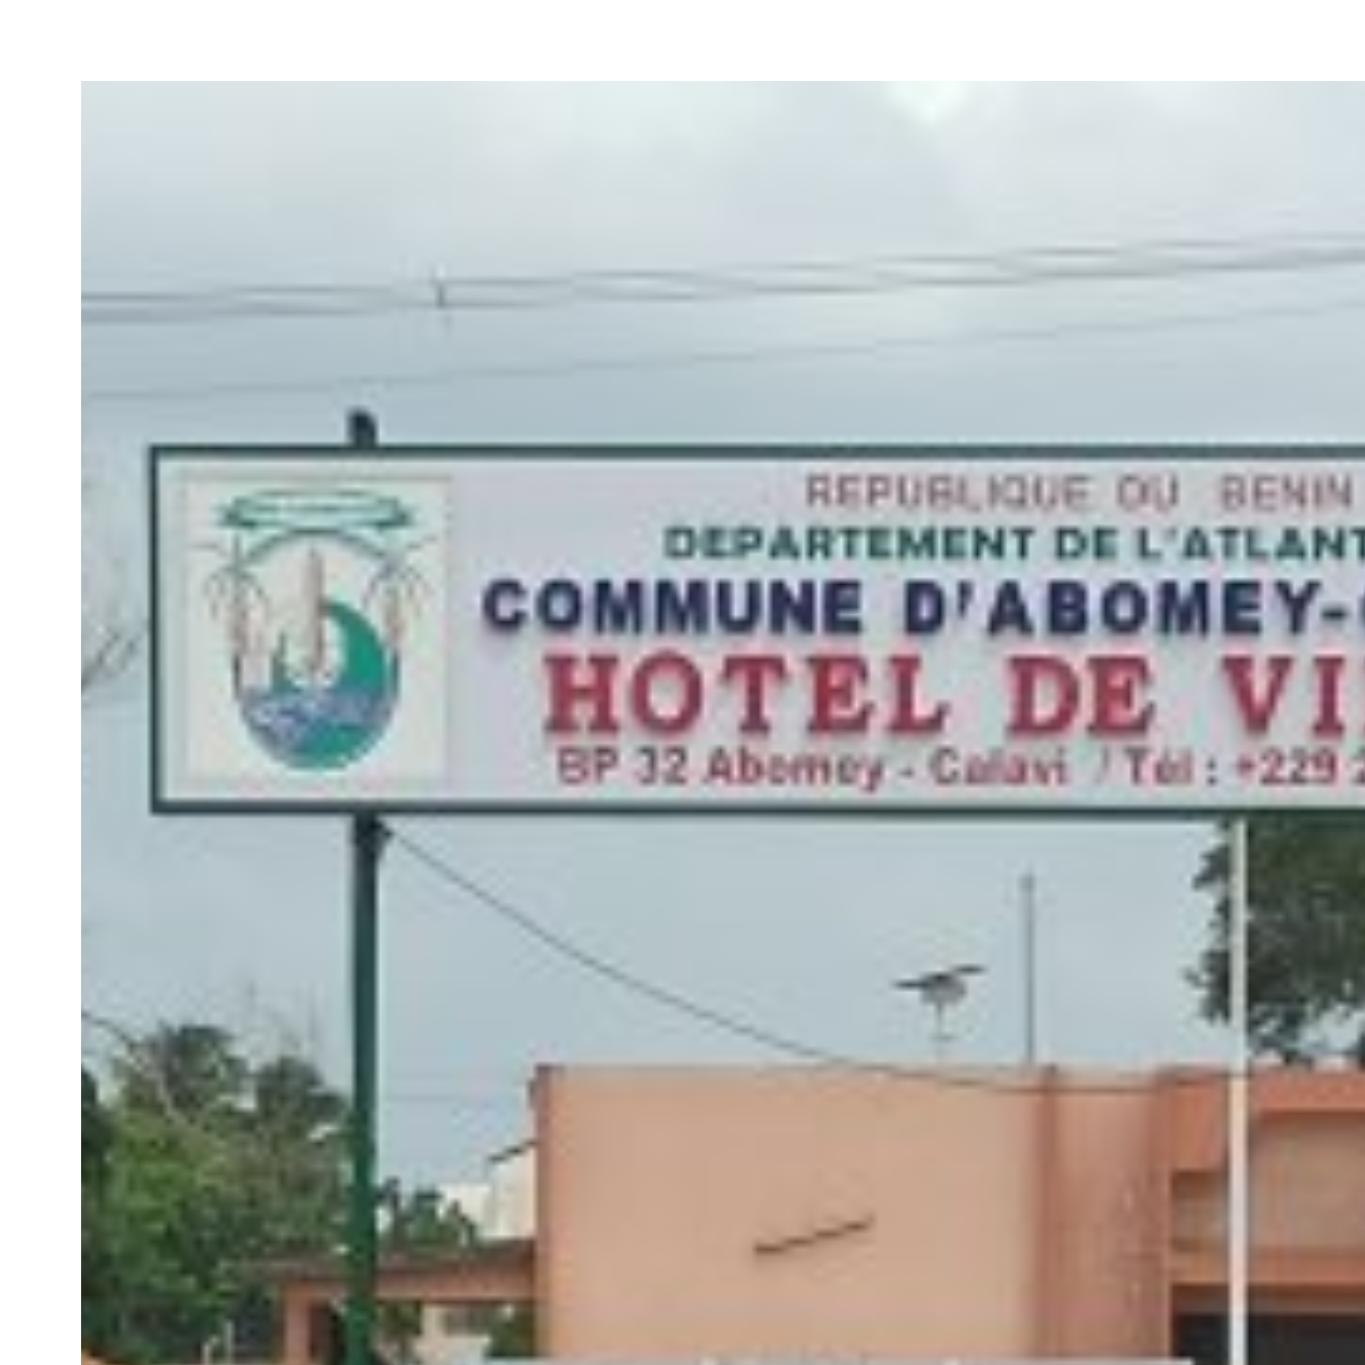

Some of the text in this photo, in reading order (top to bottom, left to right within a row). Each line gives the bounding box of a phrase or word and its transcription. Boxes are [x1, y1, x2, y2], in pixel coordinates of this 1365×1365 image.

[806, 473, 1354, 512] REPUBLIQUE DU BENIN
[664, 525, 1036, 562] DEPARTEMENT
[1054, 526, 1118, 562] DE
[482, 578, 864, 637] COMMUNE
[542, 649, 949, 741] HOTEL
[1006, 653, 1155, 741] DE
[556, 743, 620, 786] BP
[636, 743, 689, 786] 32
[702, 743, 884, 792] Abomey
[928, 743, 1068, 787] Calavi
[1235, 744, 1339, 787] +229
